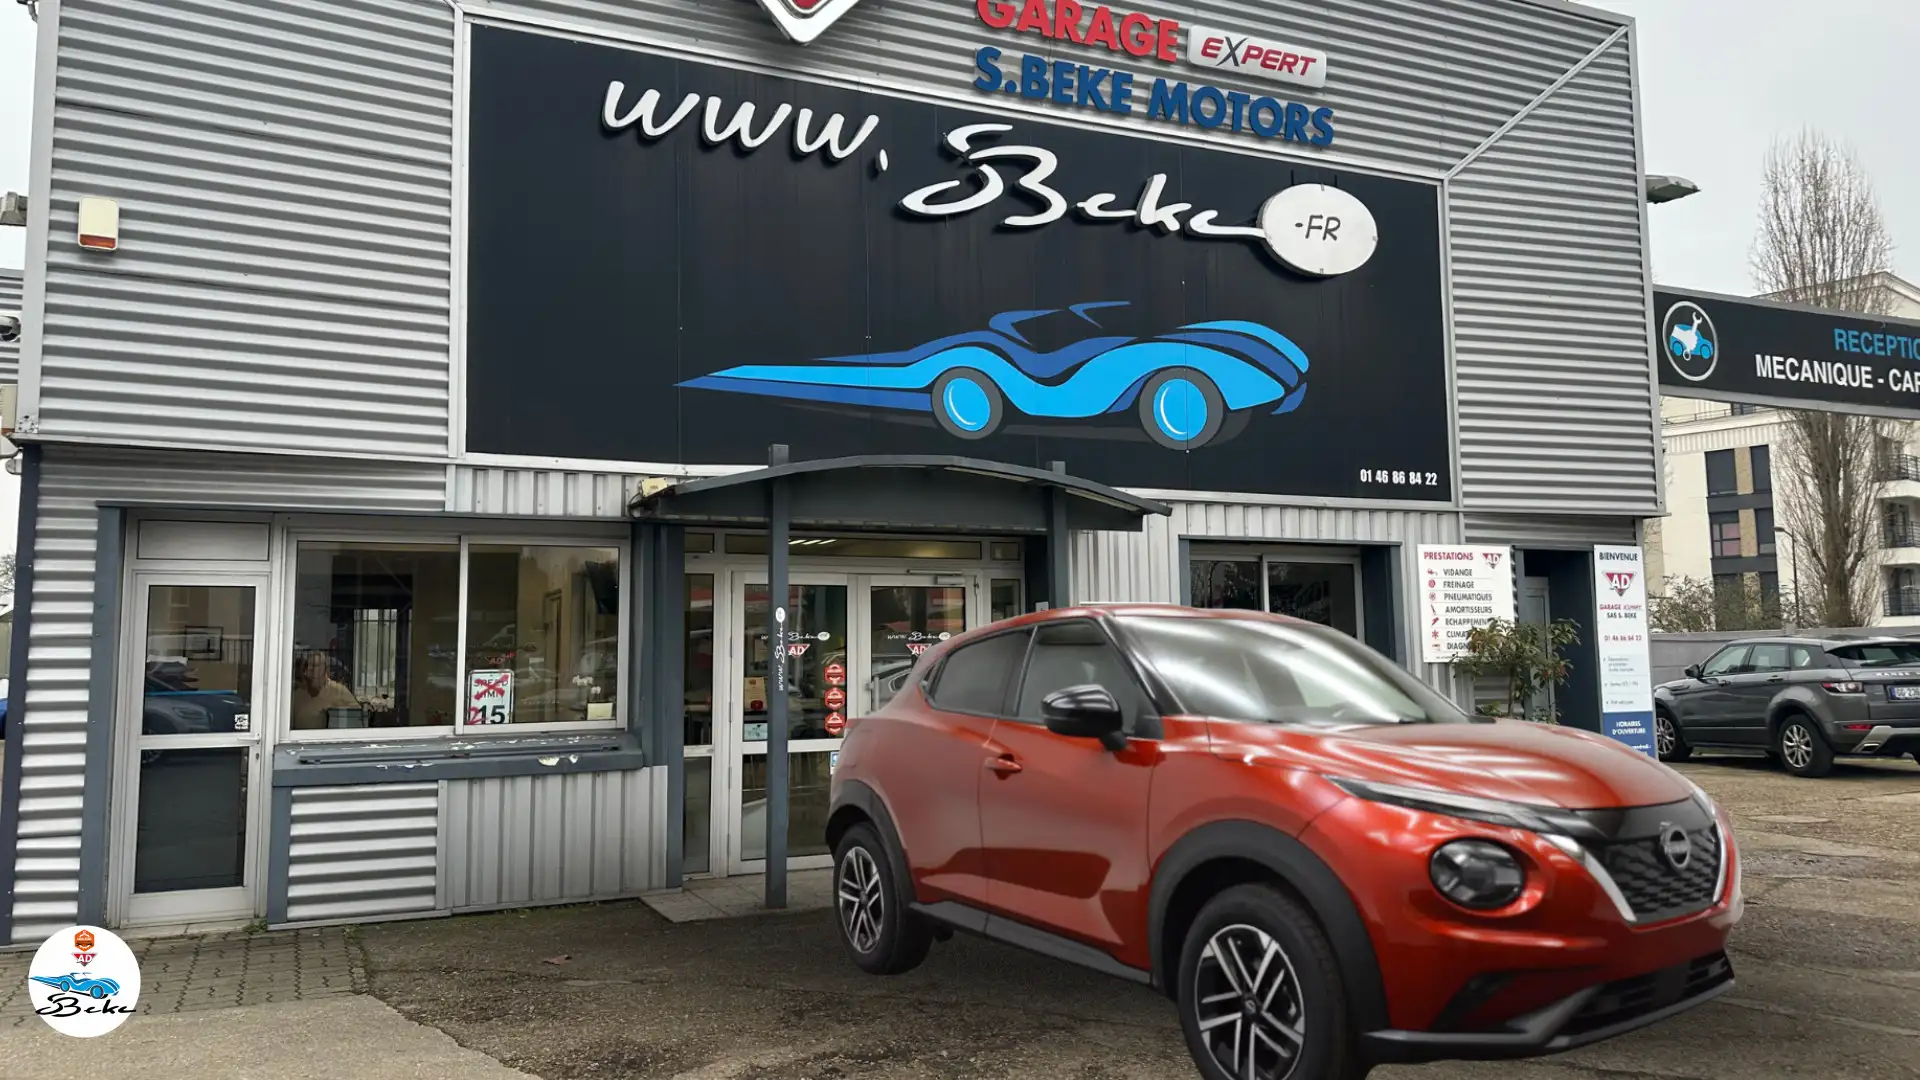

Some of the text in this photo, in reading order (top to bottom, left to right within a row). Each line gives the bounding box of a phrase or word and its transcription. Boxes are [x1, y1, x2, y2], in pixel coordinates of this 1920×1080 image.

[976, 0, 1317, 77] GARAGE EXPERT
[974, 45, 1335, 147] S.BEKE MOTORS
[1754, 353, 1874, 389] MECANIQUE
[1360, 468, 1438, 486] 01 46 86 84 22
[1423, 551, 1474, 561] PRESTATIONS
[1599, 551, 1638, 562] BIENVENUE
[1443, 568, 1473, 576] VIDANGE
[1610, 573, 1631, 590] AD
[1443, 593, 1493, 601] PNEUMATIQUES
[1445, 606, 1492, 614] AMORTISSEURS
[787, 646, 806, 656] AD
